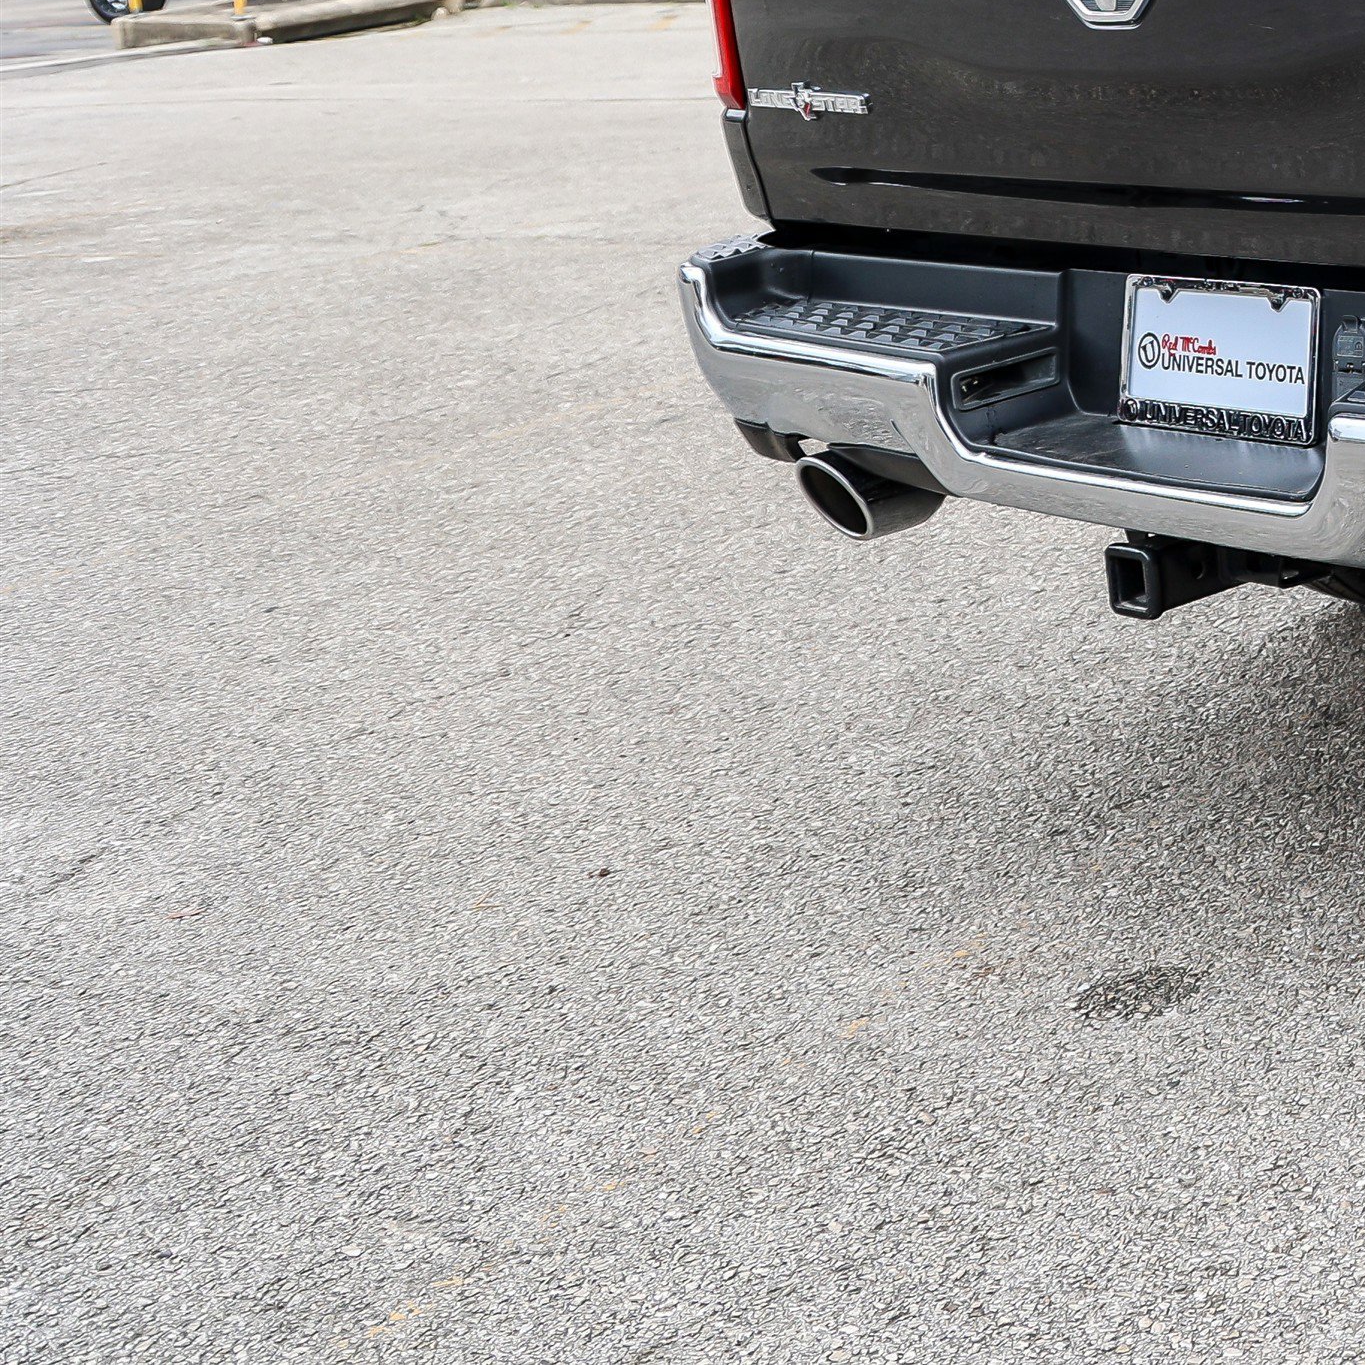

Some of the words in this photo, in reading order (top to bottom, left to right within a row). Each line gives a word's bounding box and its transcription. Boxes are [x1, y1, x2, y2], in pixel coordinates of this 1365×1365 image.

[748, 88, 797, 111] LONE
[809, 92, 868, 114] STAR
[1161, 333, 1178, 352] Red
[1161, 352, 1243, 378] UNIVERSAL
[1246, 361, 1305, 385] TOYOTA
[1144, 400, 1238, 432] UNIVERSAL
[1238, 413, 1307, 442] TOYOTA
